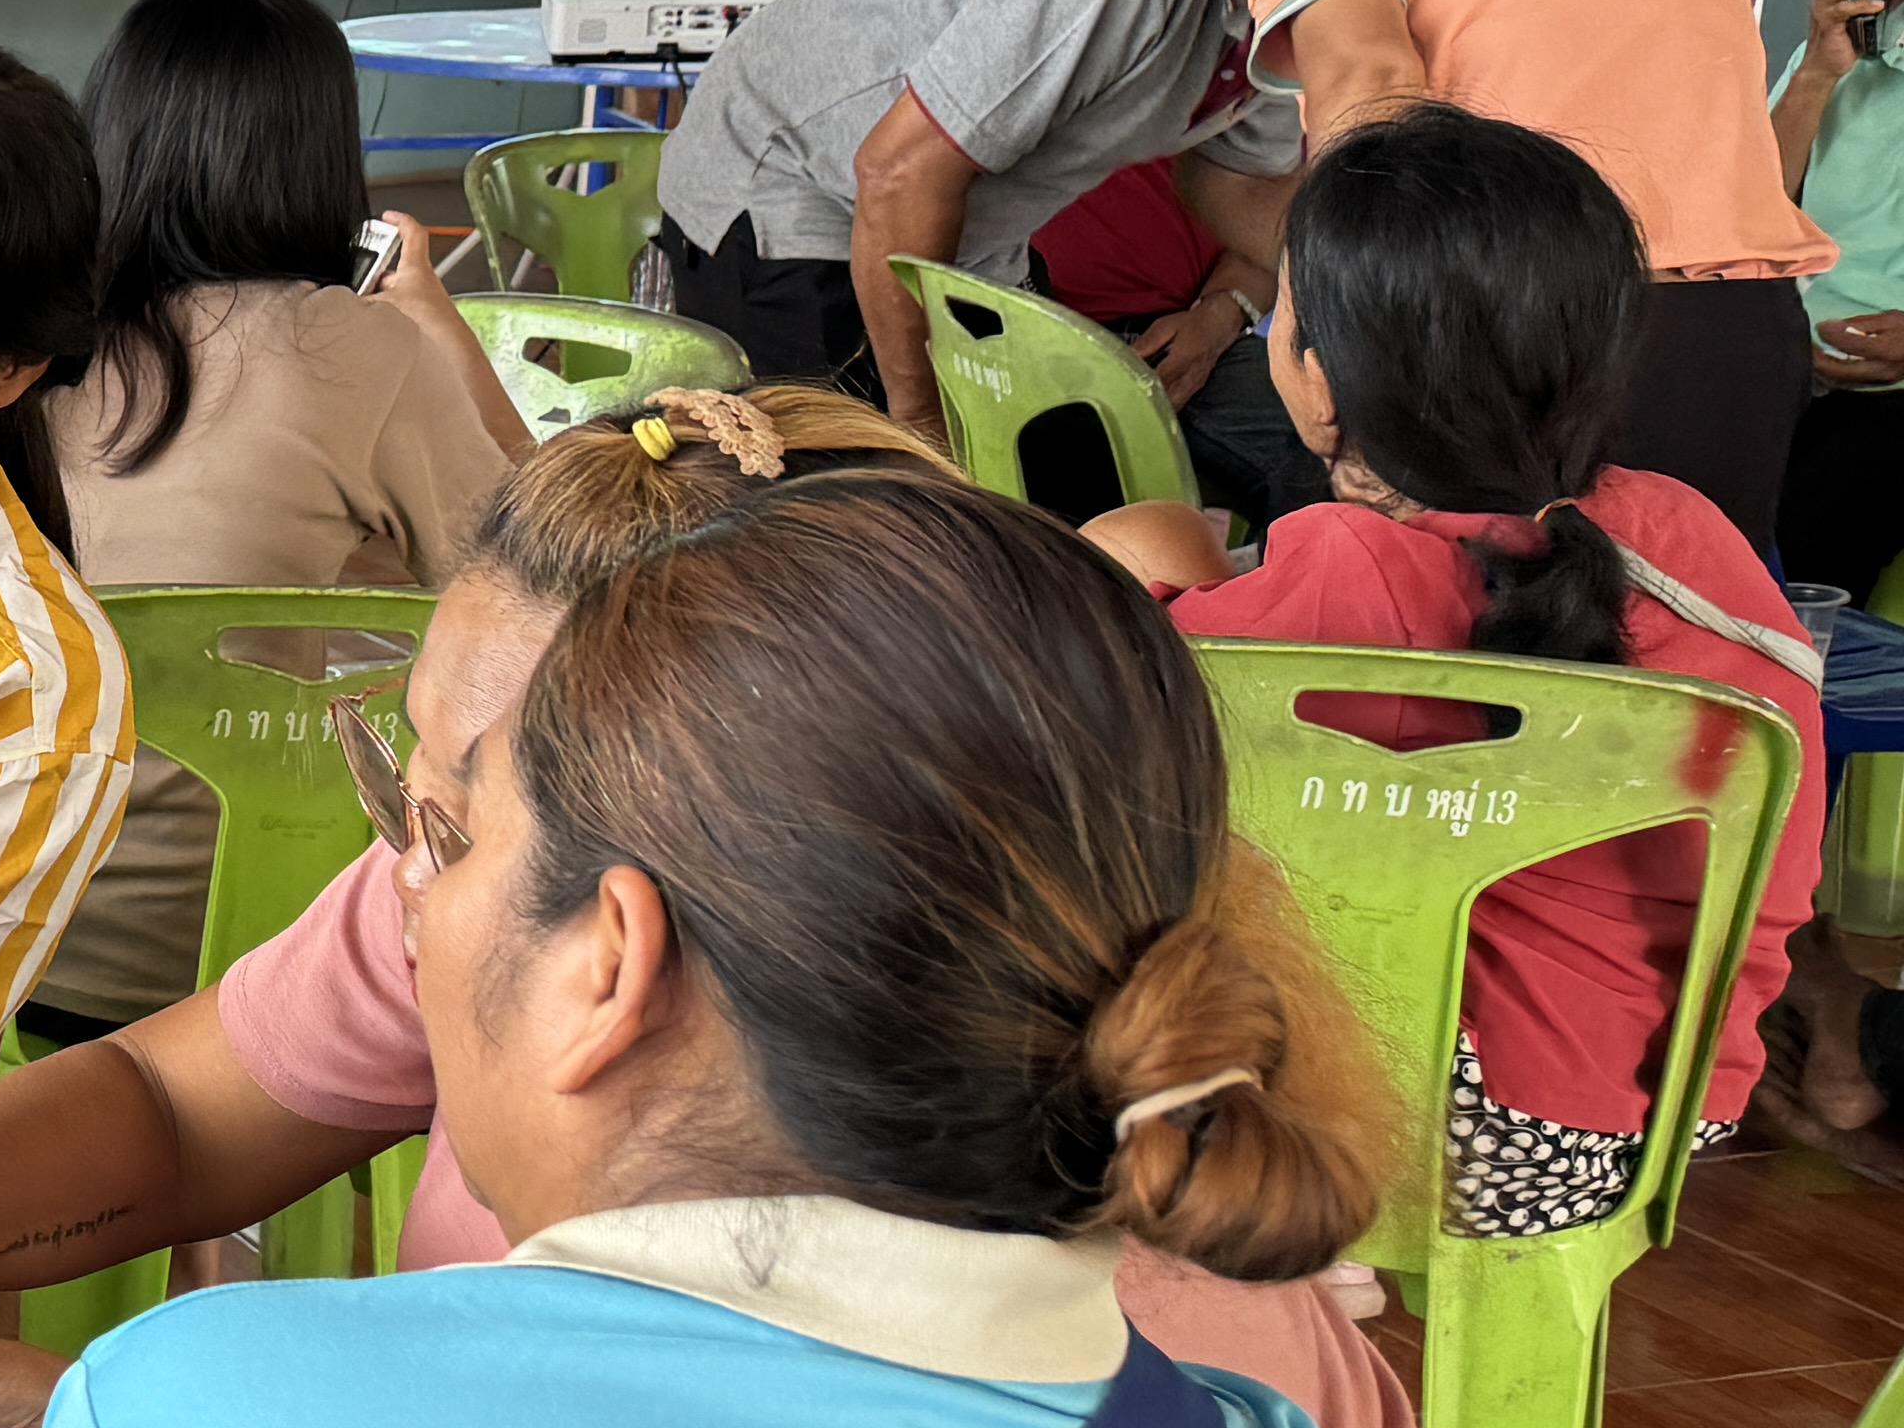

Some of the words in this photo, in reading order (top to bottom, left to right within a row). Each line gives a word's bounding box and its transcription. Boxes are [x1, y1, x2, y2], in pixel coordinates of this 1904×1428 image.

[1301, 775, 1326, 810] ก
[1342, 778, 1368, 814] ท
[1385, 782, 1413, 818] บ
